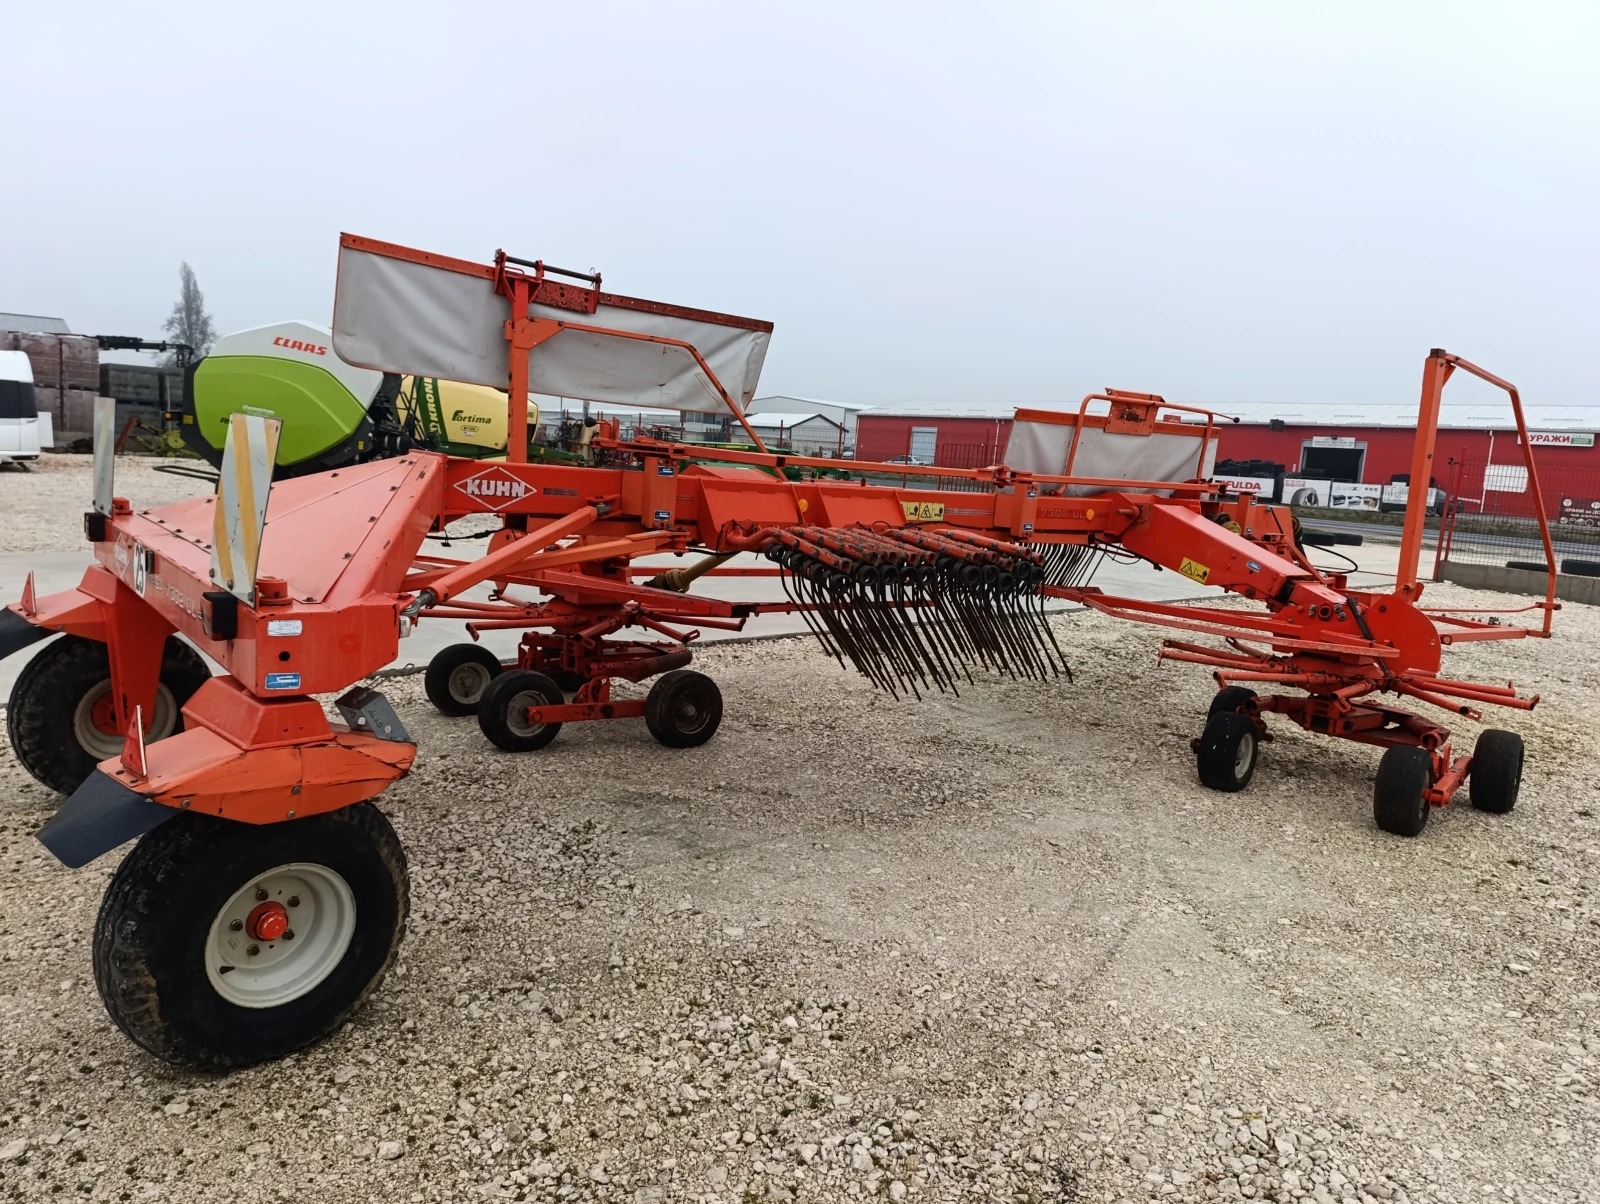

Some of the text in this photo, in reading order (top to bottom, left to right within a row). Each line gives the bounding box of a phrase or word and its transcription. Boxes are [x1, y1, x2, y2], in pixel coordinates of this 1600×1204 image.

[273, 336, 328, 356] CLAAS
[452, 410, 491, 424] Fortima
[1528, 434, 1570, 443] УРАЖИ
[466, 478, 526, 498] KUHN
[1226, 481, 1261, 491] FULDA
[1041, 508, 1068, 518] 7302
[134, 544, 144, 594] 25
